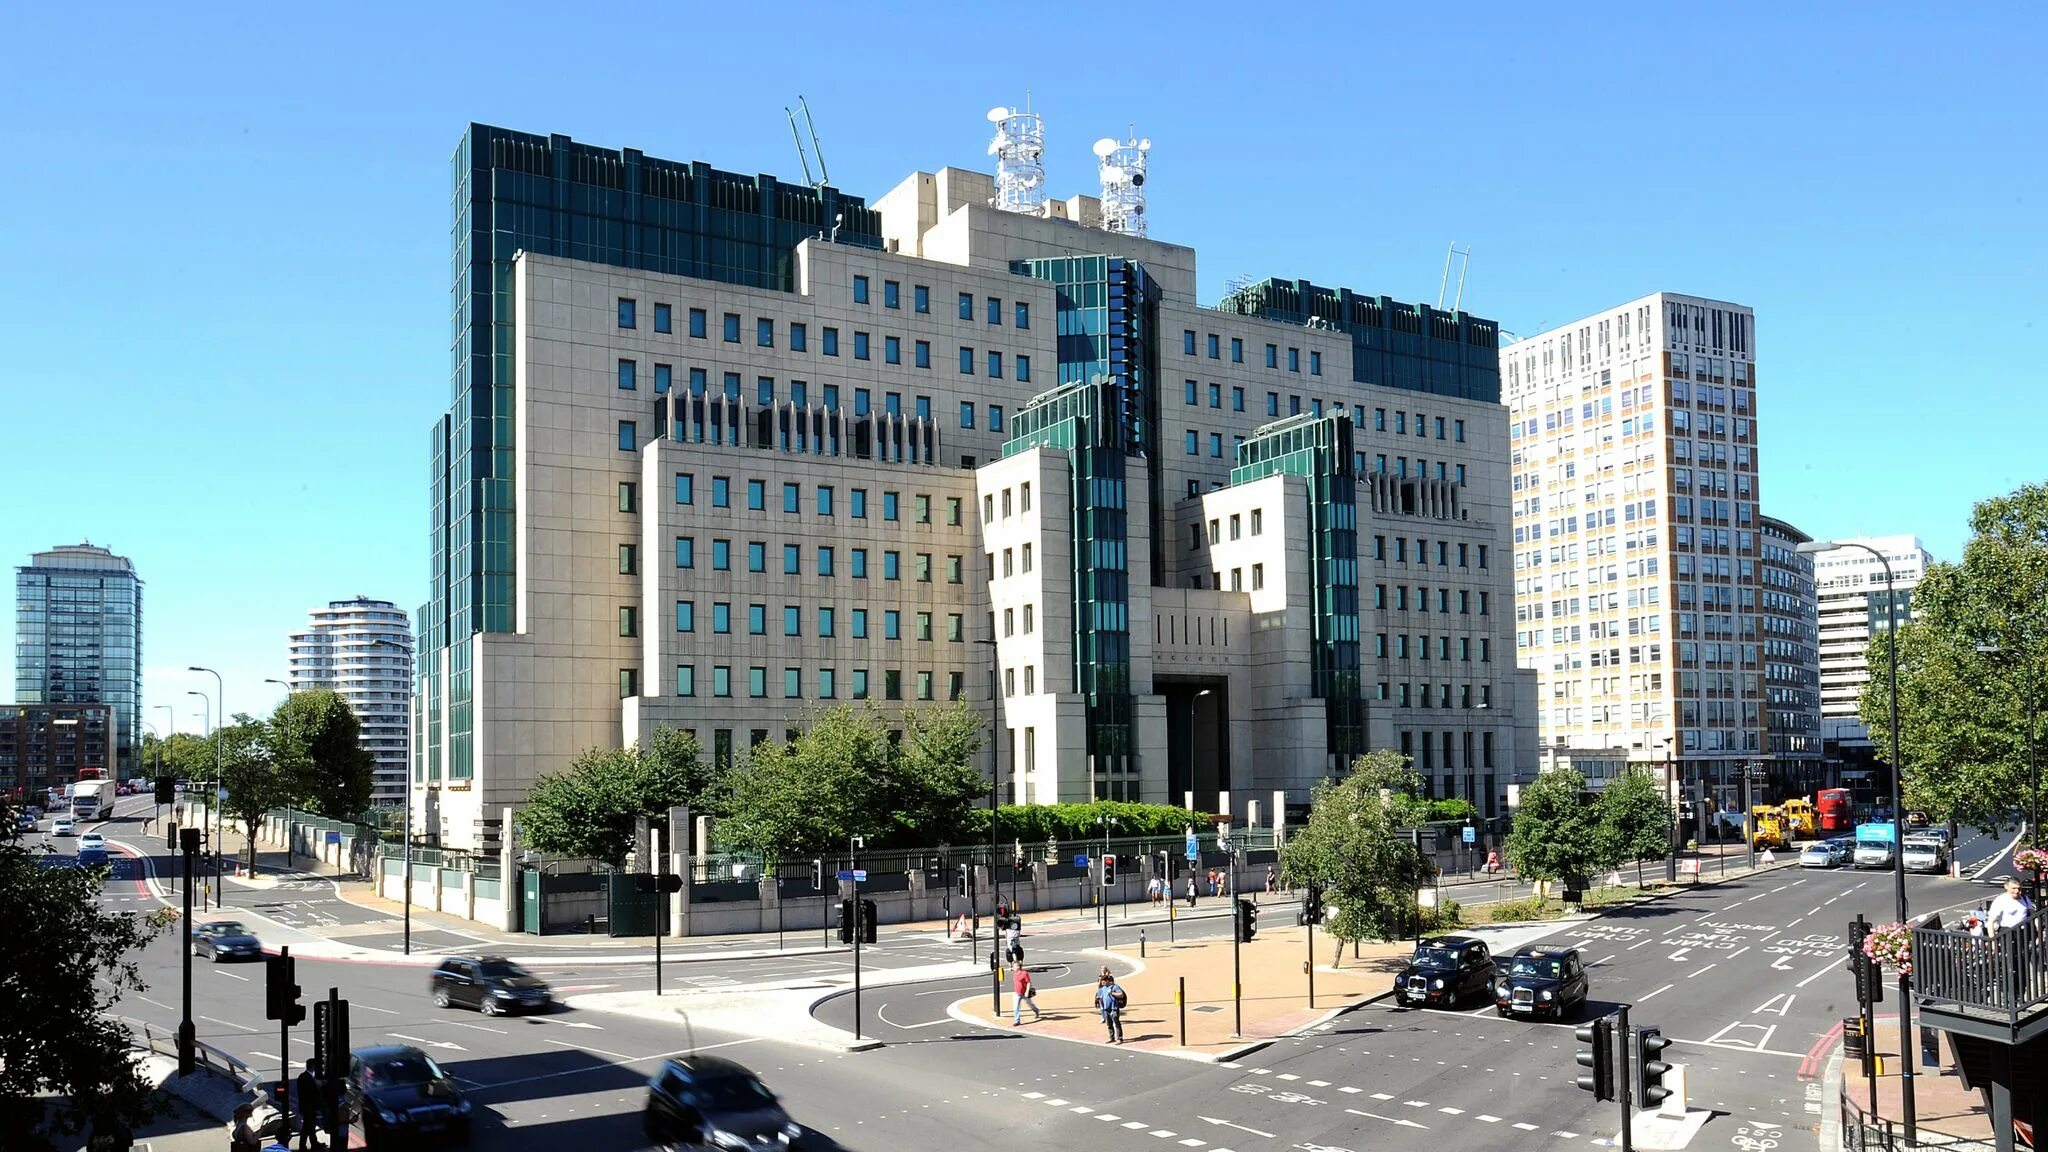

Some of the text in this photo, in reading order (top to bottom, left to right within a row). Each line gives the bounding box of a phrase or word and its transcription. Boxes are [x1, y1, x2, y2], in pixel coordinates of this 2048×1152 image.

[1803, 934, 1840, 943] (E)
[1776, 939, 1846, 950] ROAD
[1762, 946, 1834, 957] RING
[1737, 1127, 1783, 1138] CS5
